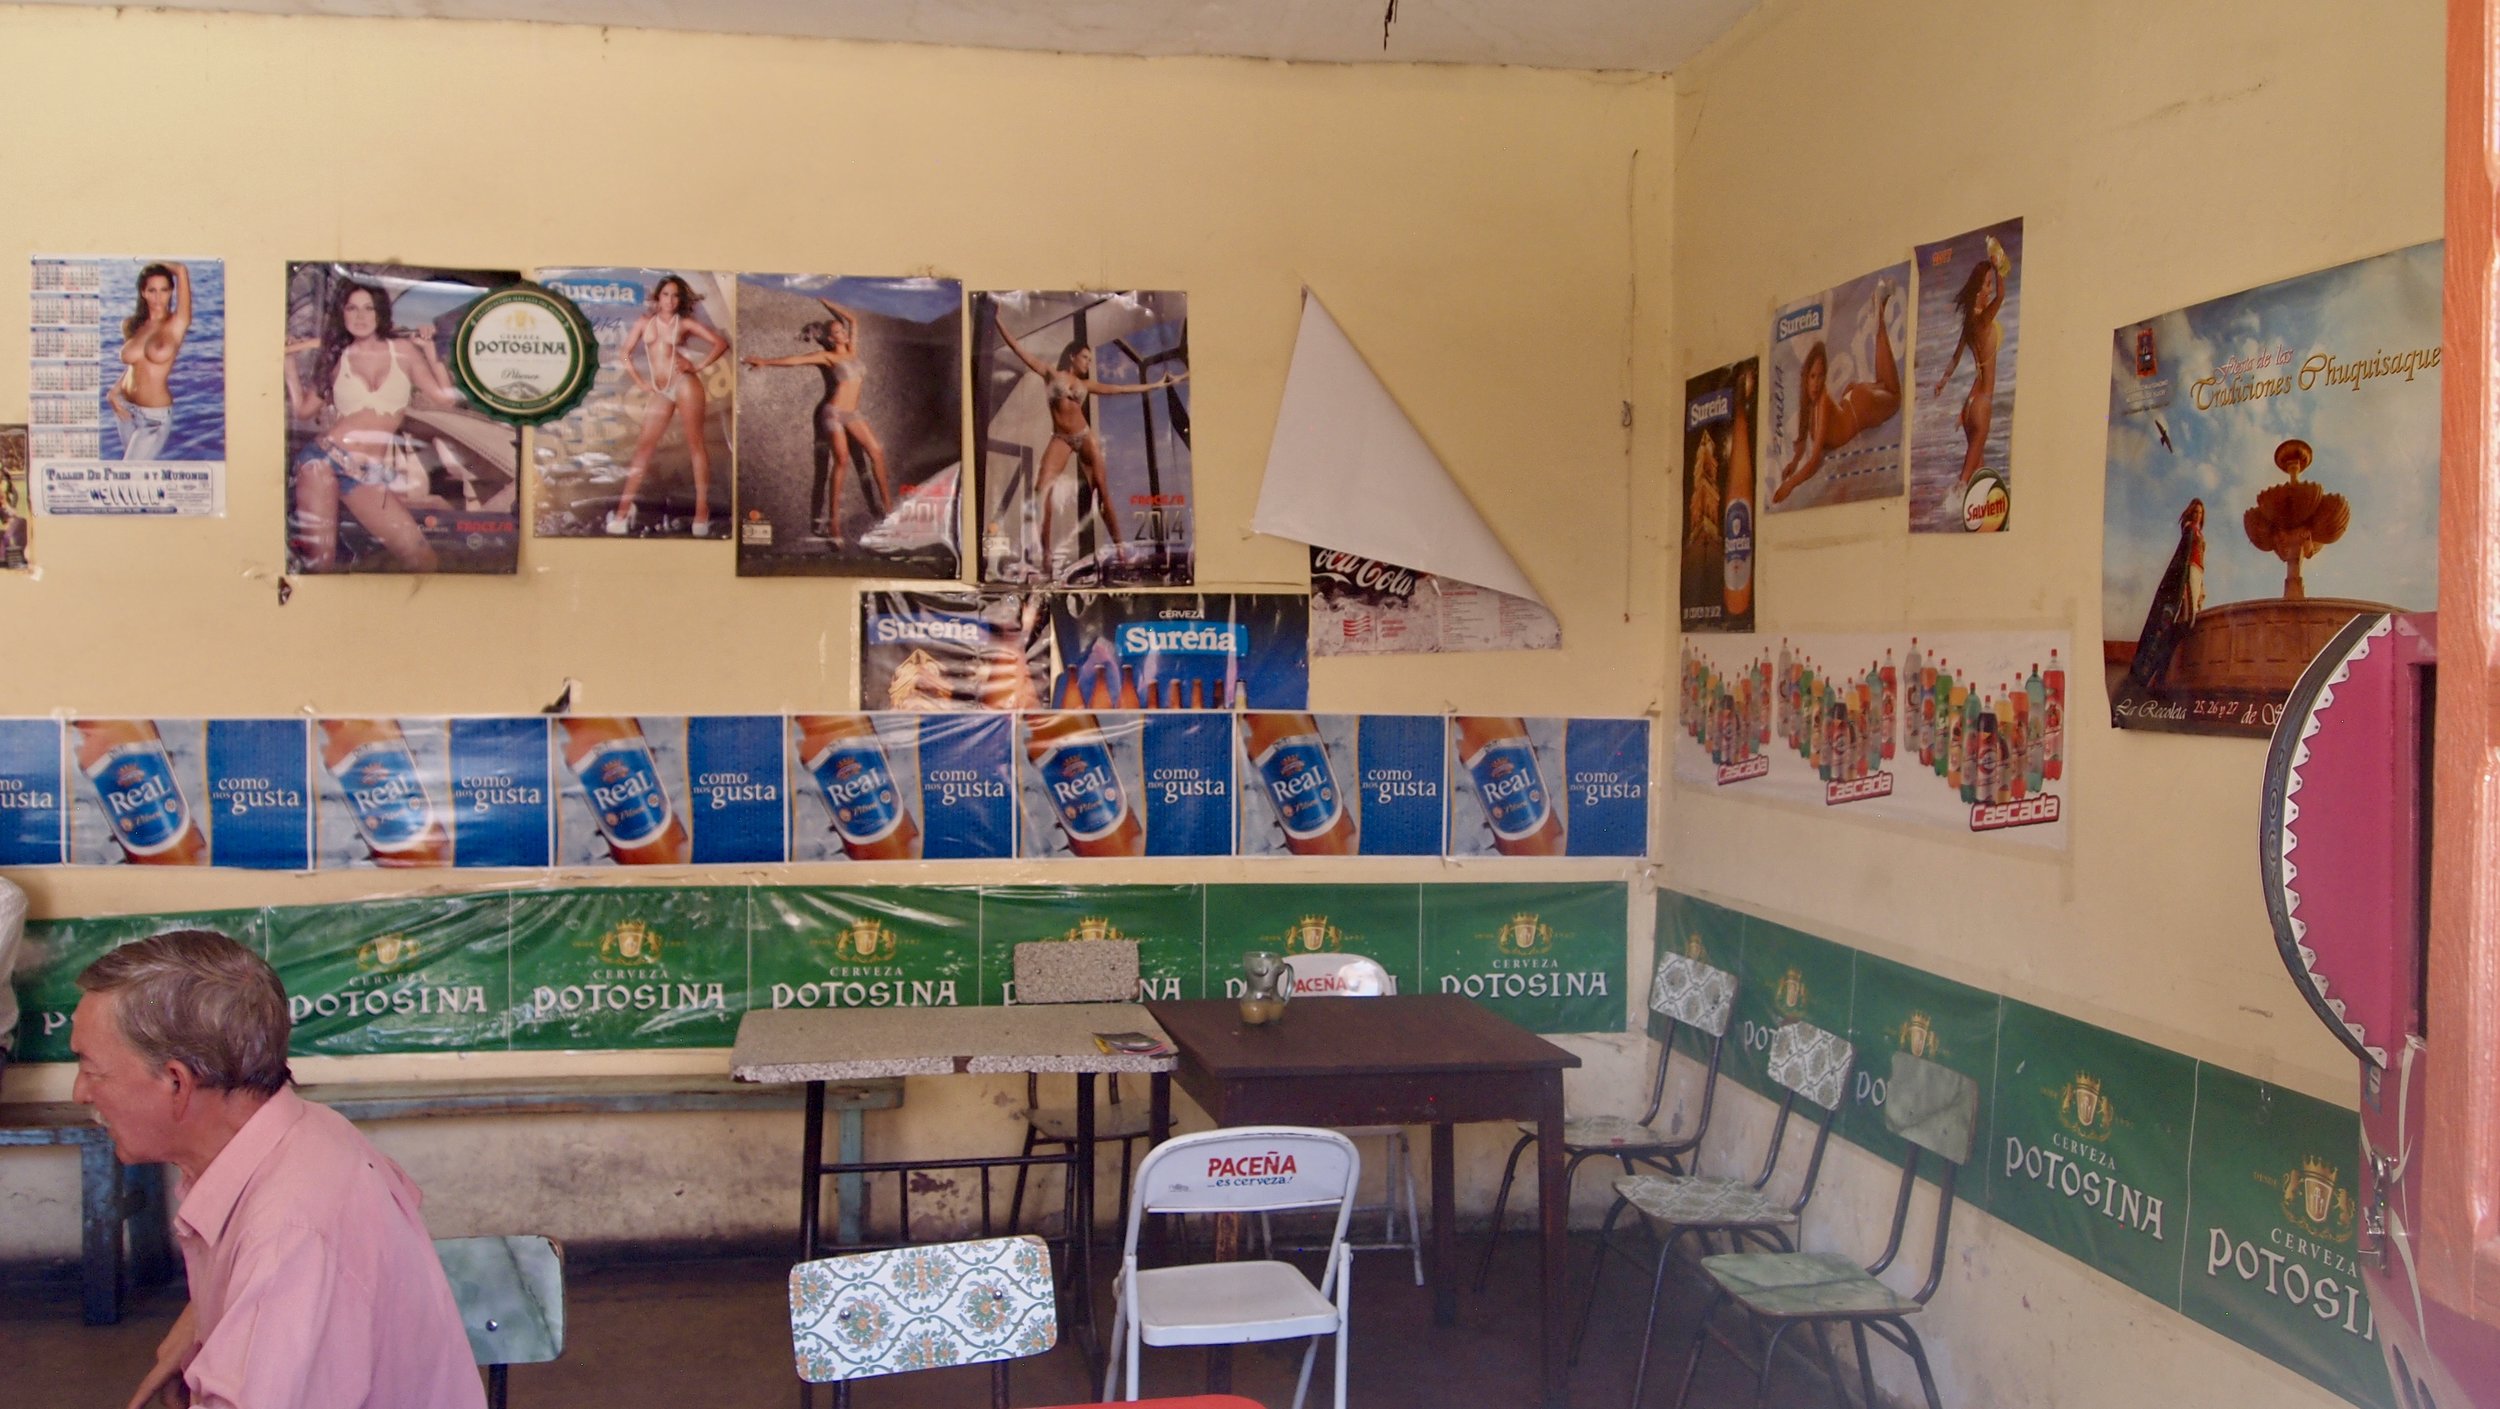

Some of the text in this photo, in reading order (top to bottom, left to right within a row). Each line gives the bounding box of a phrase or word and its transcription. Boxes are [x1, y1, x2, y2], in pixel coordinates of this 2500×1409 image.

[1778, 307, 1820, 340] Sureña
[474, 340, 567, 356] POTOSINA
[2190, 374, 2292, 411] Tradiciones
[1690, 393, 1728, 427] Sureña
[1158, 609, 1205, 620] CERVEZA
[877, 617, 980, 643] Sureña
[1125, 626, 1237, 653] Sureña
[2115, 699, 2136, 716] La
[2138, 700, 2188, 720] Recoleta
[2226, 701, 2240, 715] 27
[2241, 704, 2257, 725] de
[461, 775, 511, 788] como
[698, 772, 748, 785] como
[930, 769, 977, 782] como
[1153, 768, 1199, 780] como
[1367, 769, 1412, 781] como
[1575, 771, 1618, 783] como
[1718, 757, 1768, 781] Cascada
[218, 776, 269, 790] como
[711, 783, 777, 809] gusta
[924, 780, 1005, 806] nos gusta
[1164, 778, 1225, 804] gusta
[1378, 779, 1437, 804] gusta
[1585, 782, 1641, 805] gusta
[1828, 773, 1892, 800] Cascada
[231, 788, 300, 816] gusta
[473, 785, 541, 813] gusta
[1972, 795, 2058, 827] Cascada
[591, 968, 671, 980] CERVEZA
[829, 966, 904, 977] CERVEZA
[1492, 959, 1560, 969] CERVEZA
[771, 980, 959, 1009] POTOSINA
[1293, 972, 1348, 994] ACEÑA
[1440, 971, 1609, 998] POTOSINA
[288, 986, 488, 1025] POTOSINA
[533, 982, 726, 1019] POTOSINA
[1207, 1151, 1297, 1177] PACEÑA
[2052, 1132, 2117, 1171] CERVEZA
[2005, 1136, 2164, 1241] POTOSINA
[2270, 1227, 2359, 1279] CERVEZA
